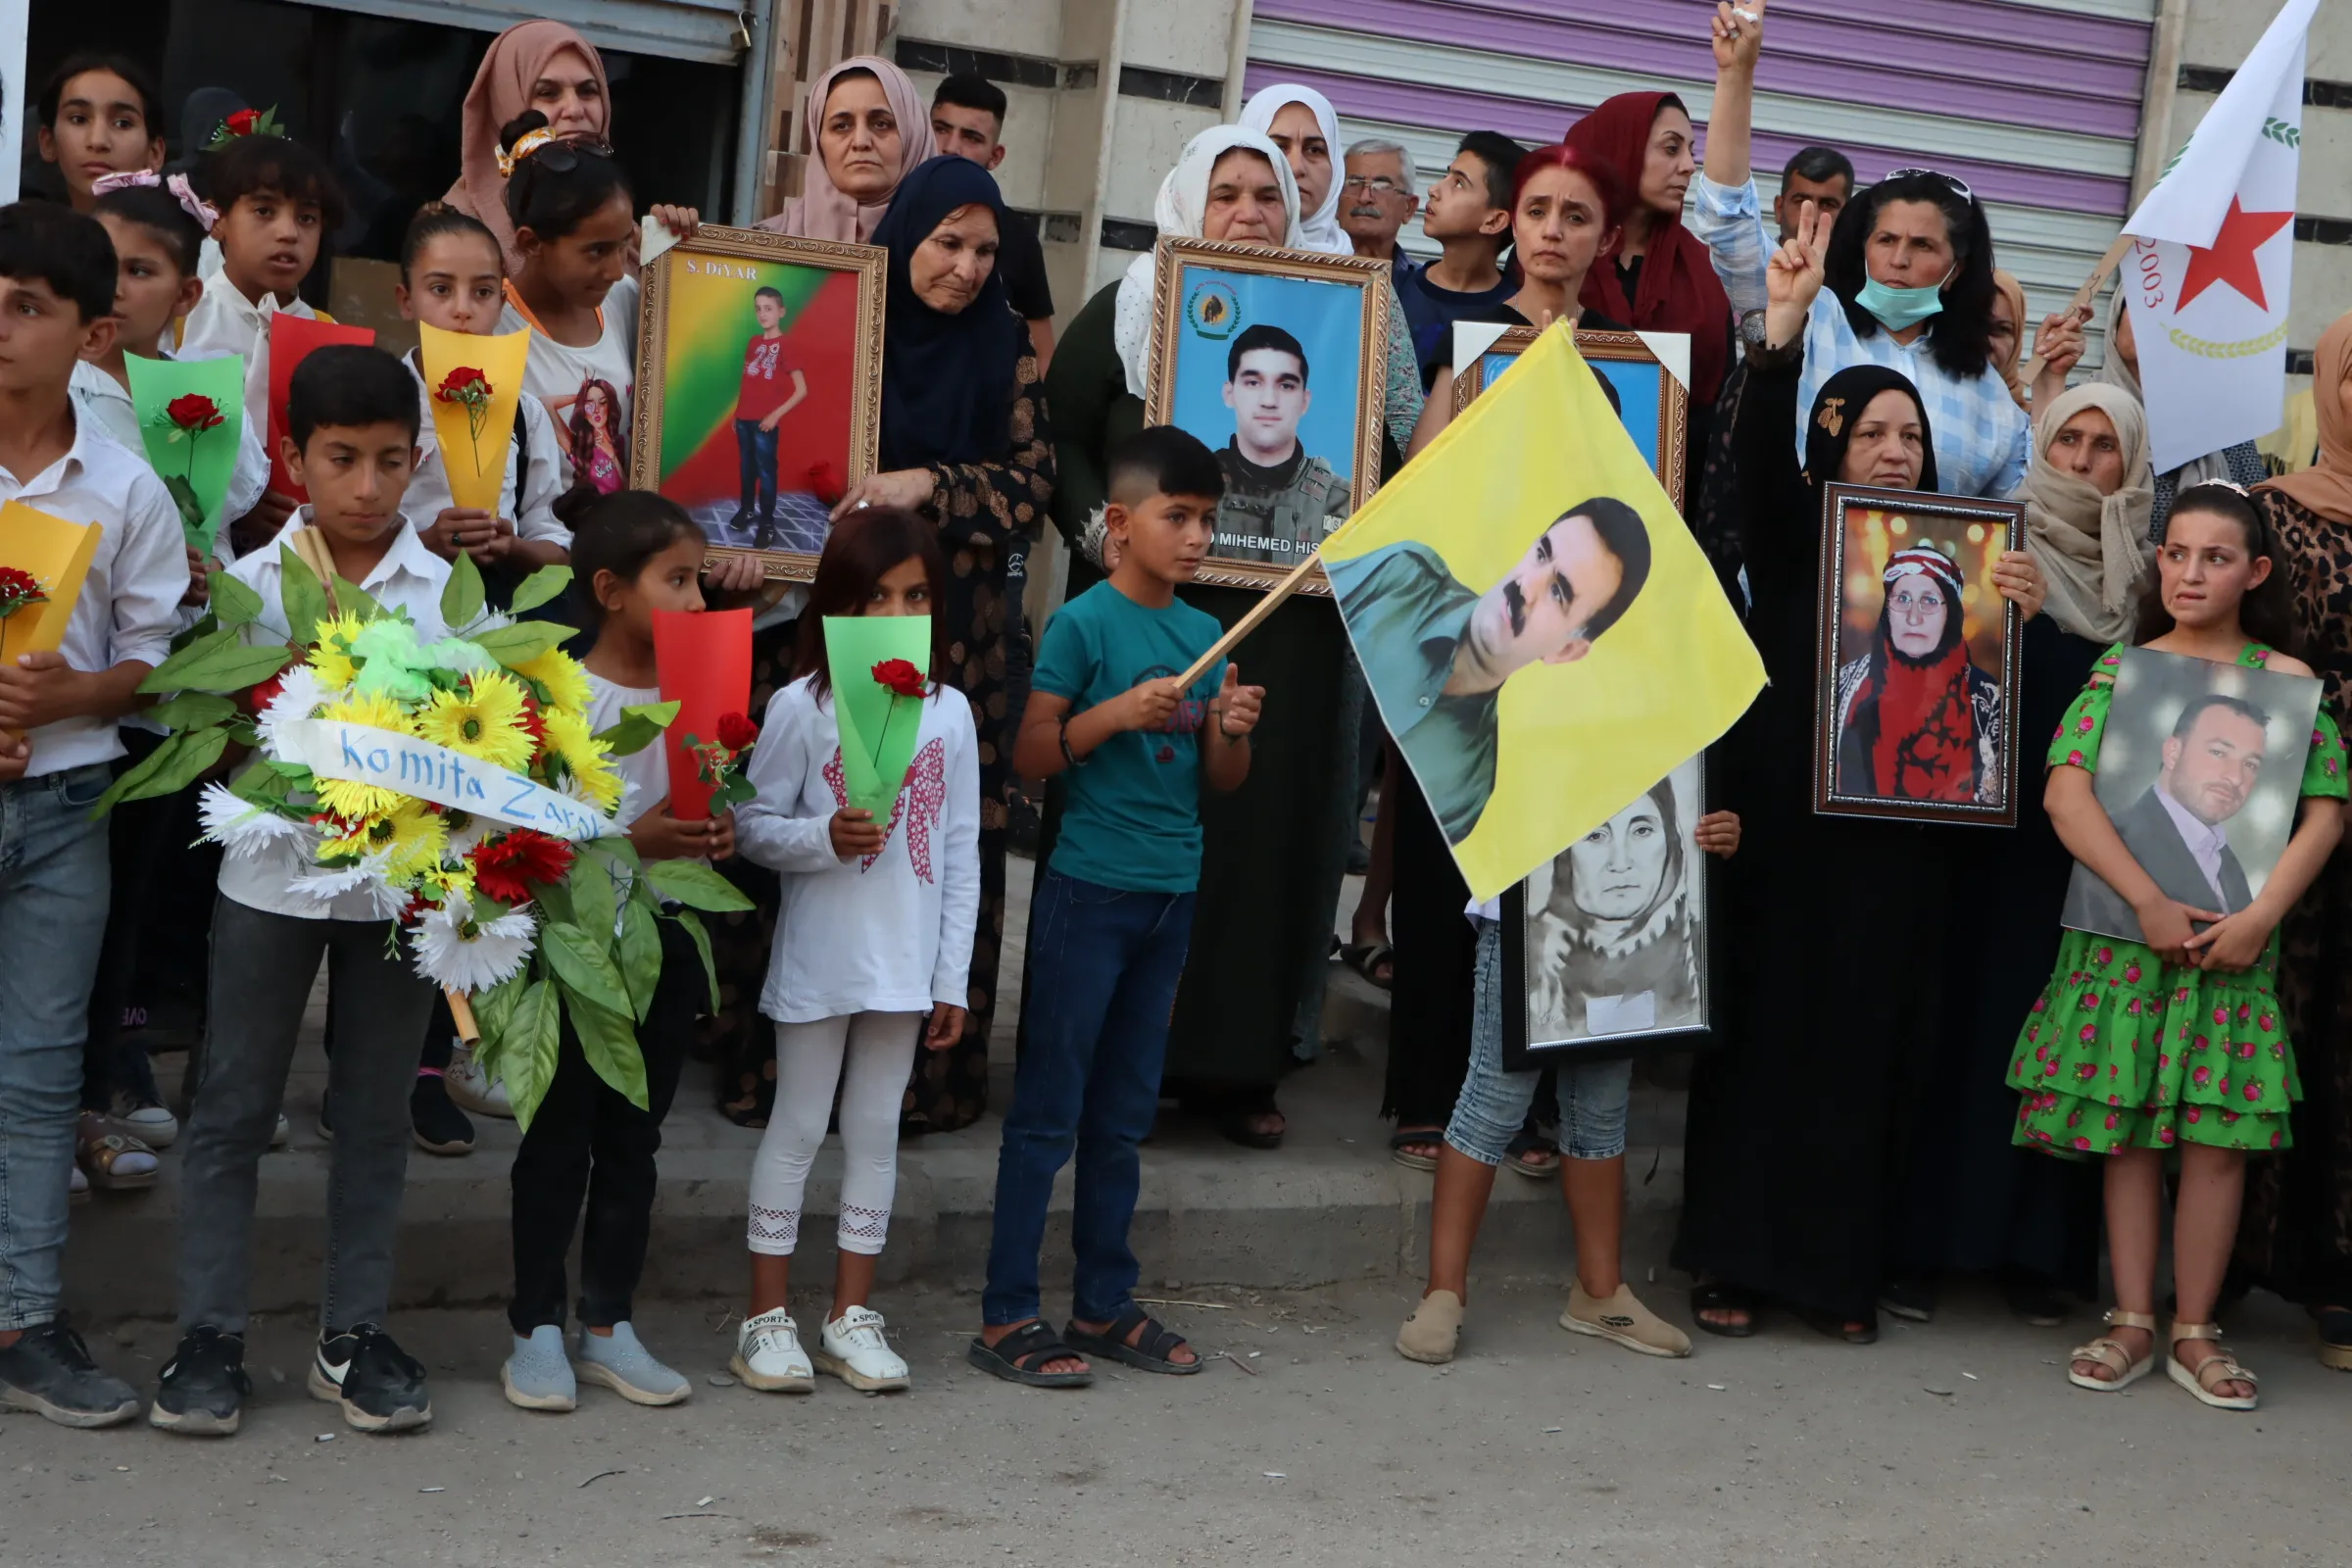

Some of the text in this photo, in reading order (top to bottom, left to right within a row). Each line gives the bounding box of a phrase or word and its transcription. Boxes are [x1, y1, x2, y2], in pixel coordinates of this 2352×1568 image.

[2134, 238, 2164, 309] 2003
[1219, 532, 1292, 553] MIHEMED
[340, 728, 486, 800] Komita
[753, 1315, 784, 1327] SPORT
